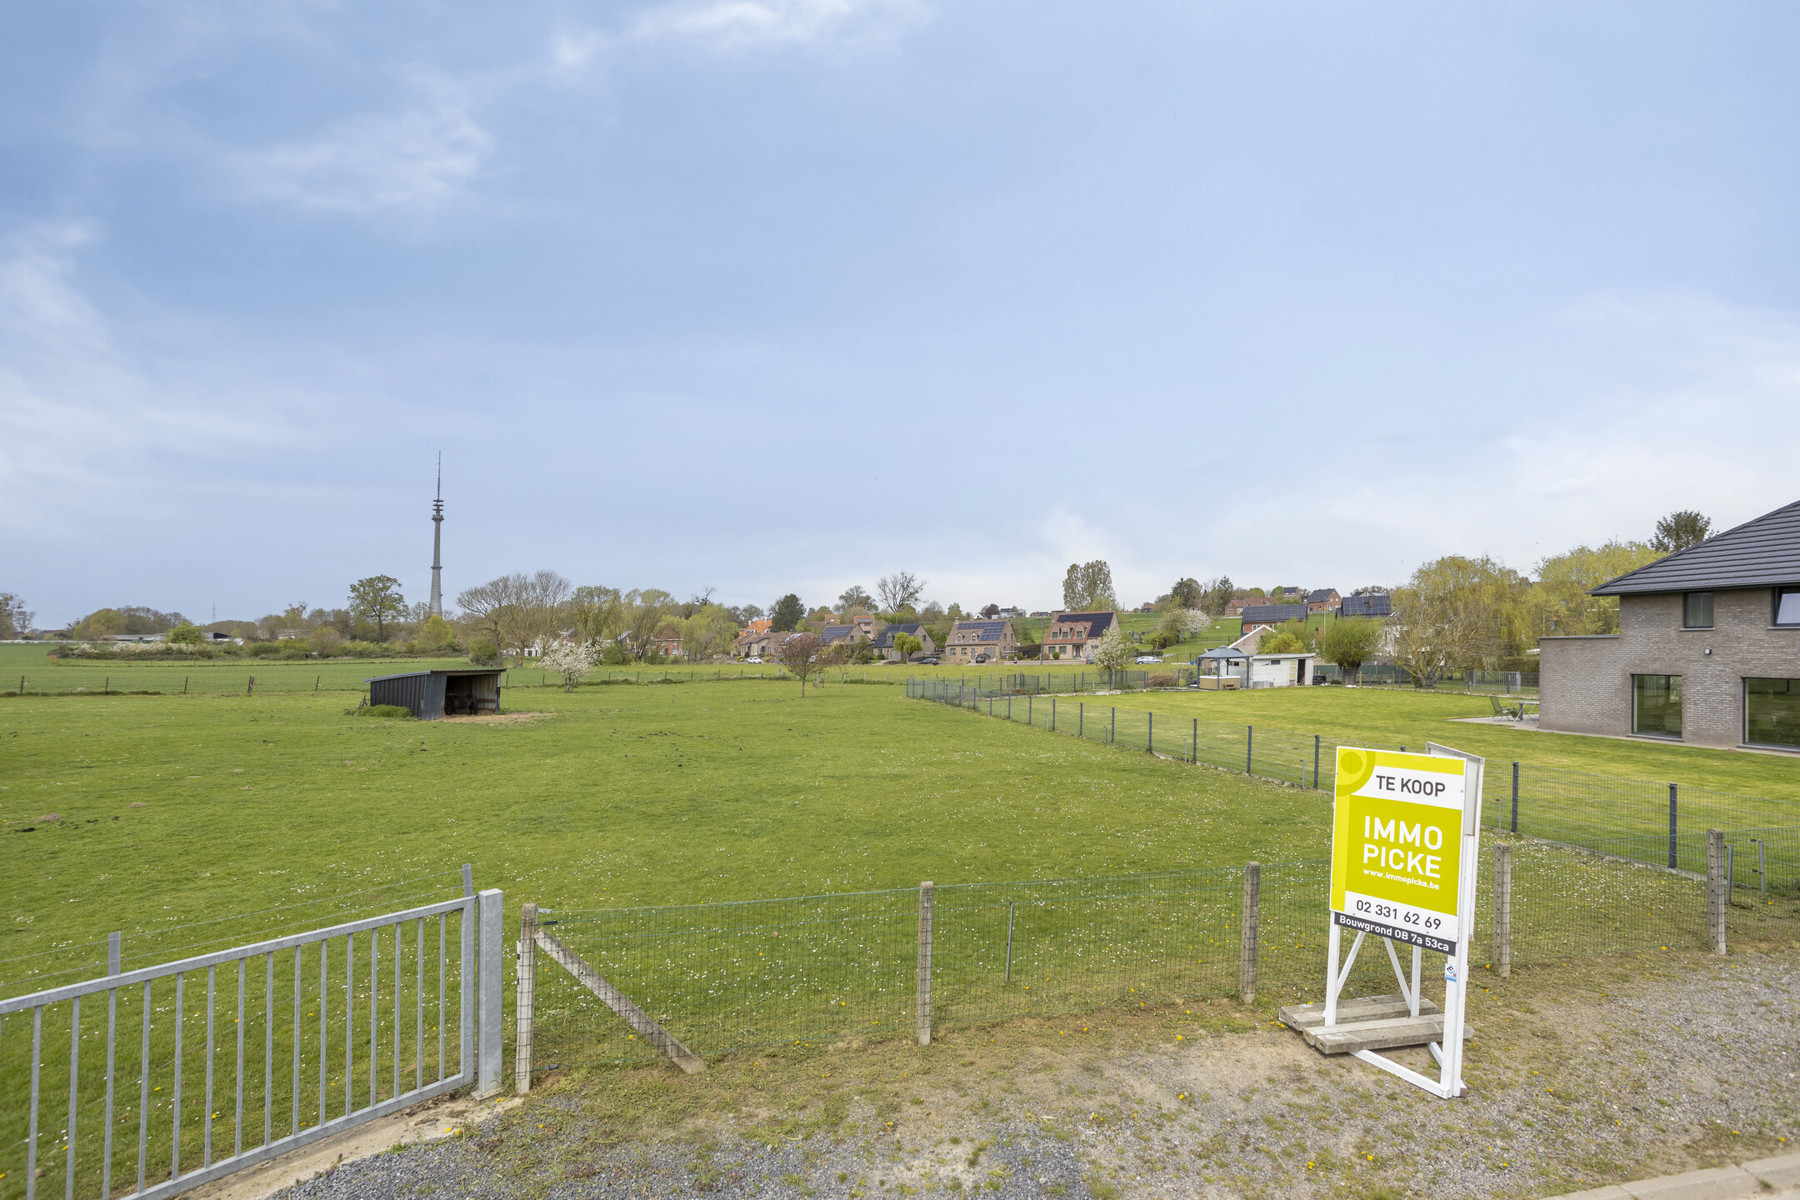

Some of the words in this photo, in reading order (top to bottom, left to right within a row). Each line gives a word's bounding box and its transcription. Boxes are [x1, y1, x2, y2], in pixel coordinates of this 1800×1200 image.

[1376, 775, 1395, 791] TE
[1401, 778, 1446, 797] KOOP
[1364, 815, 1443, 850] IMMO
[1363, 843, 1442, 879] PICKE
[1363, 868, 1440, 890] www.immopicke.be
[1356, 899, 1371, 914] 02
[1375, 904, 1398, 920] 331
[1403, 911, 1420, 926] 62
[1424, 916, 1442, 930] 69
[1339, 915, 1392, 936] Bouwgrond
[1411, 933, 1423, 945] 7a
[1425, 937, 1450, 952] 53ca
